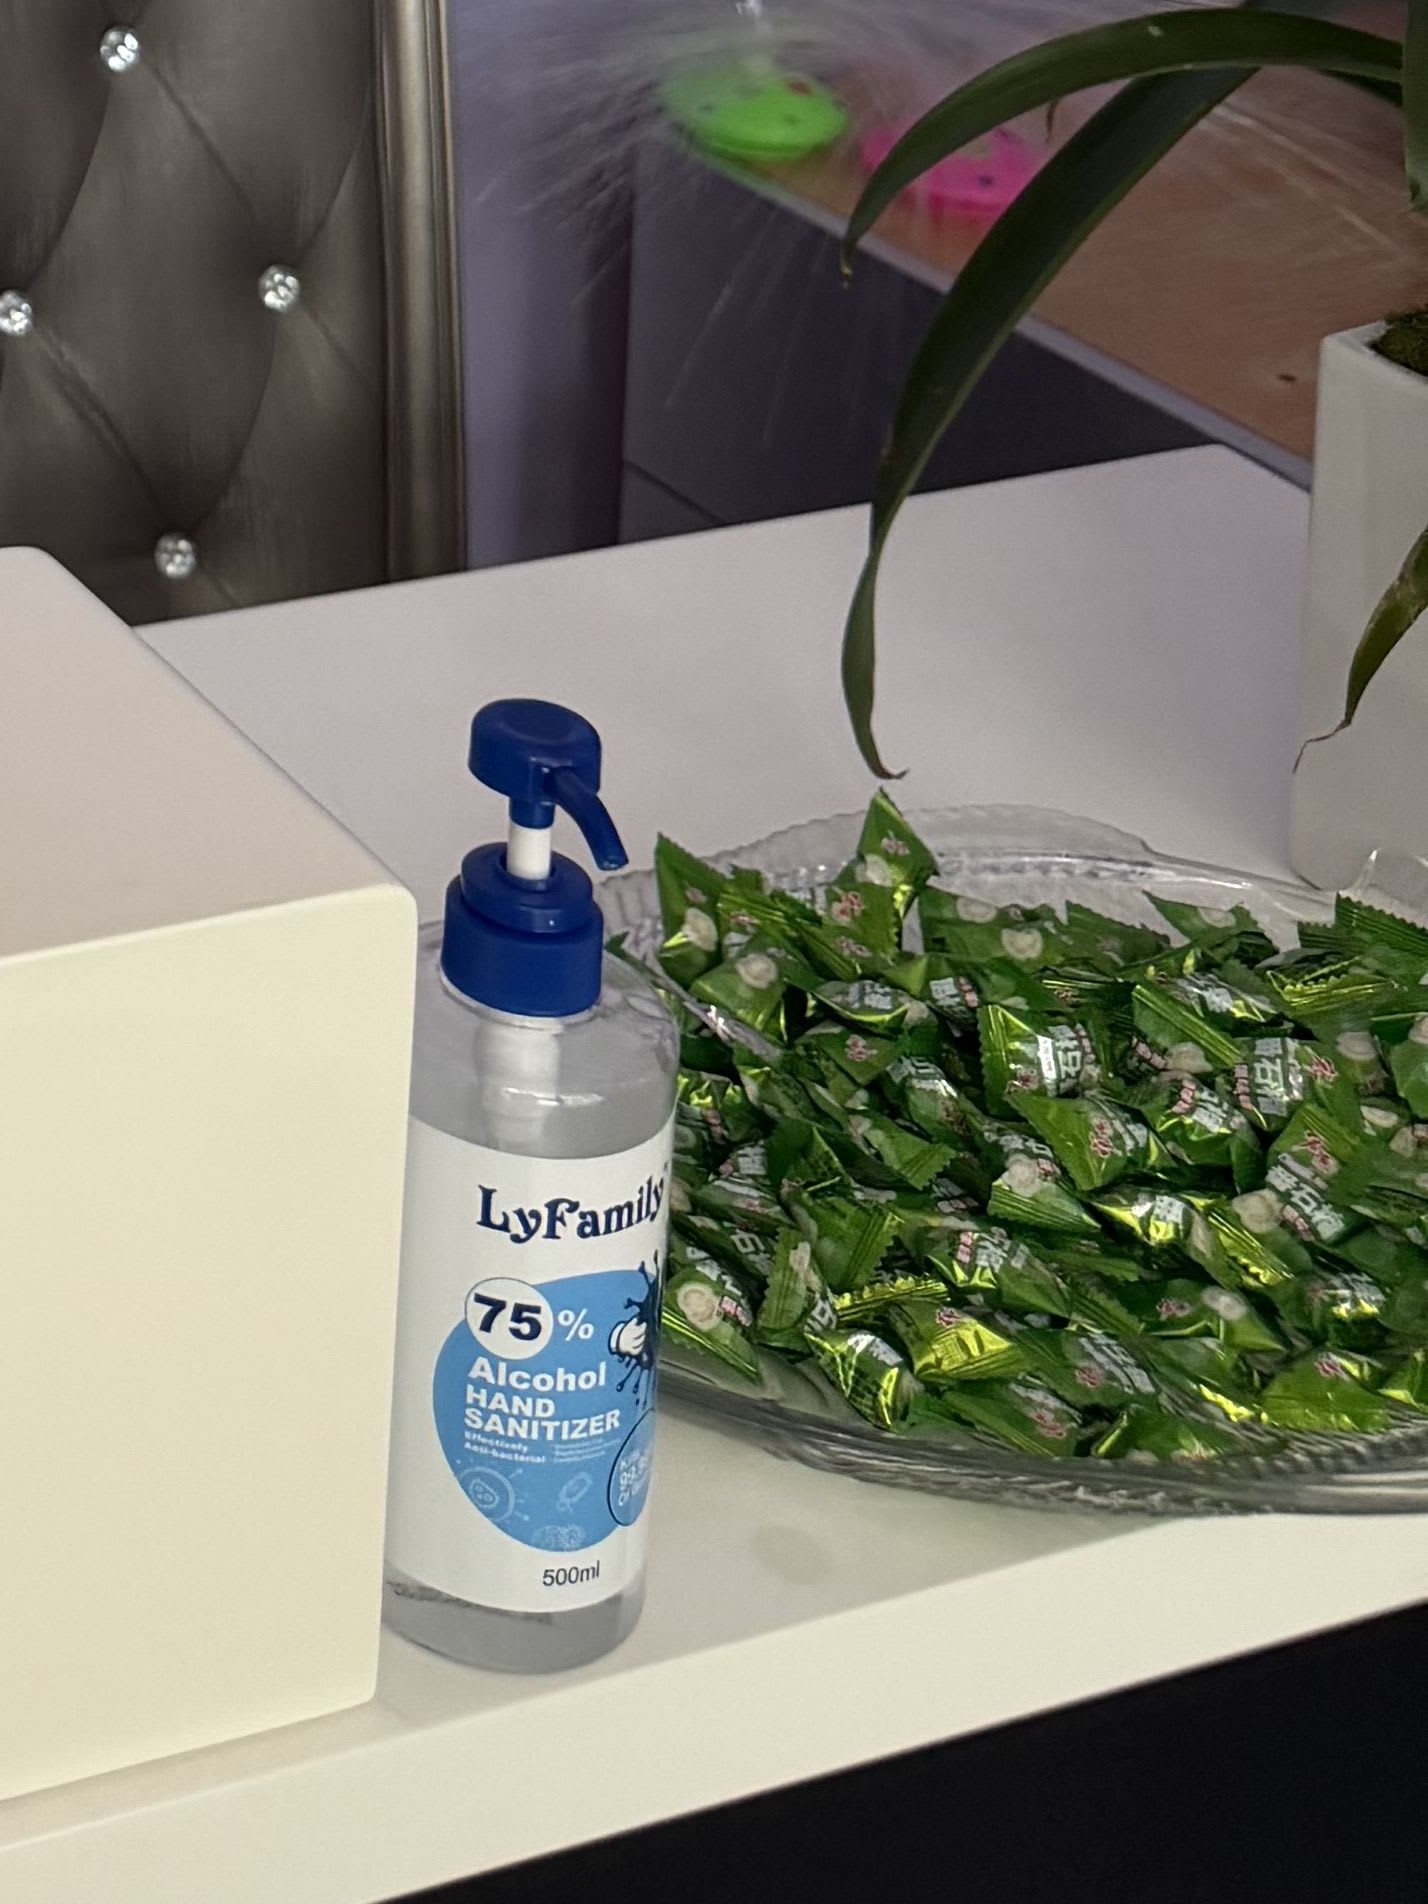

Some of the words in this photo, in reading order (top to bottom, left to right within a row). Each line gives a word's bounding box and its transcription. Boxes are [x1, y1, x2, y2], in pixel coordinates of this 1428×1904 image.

[476, 1176, 667, 1244] LyFamily
[472, 1293, 543, 1342] 75
[557, 1309, 595, 1342] %
[466, 1356, 607, 1393] Alcohol
[465, 1382, 557, 1418] HAND
[463, 1407, 622, 1442] SANITIZER
[541, 1560, 601, 1589] 500ml
